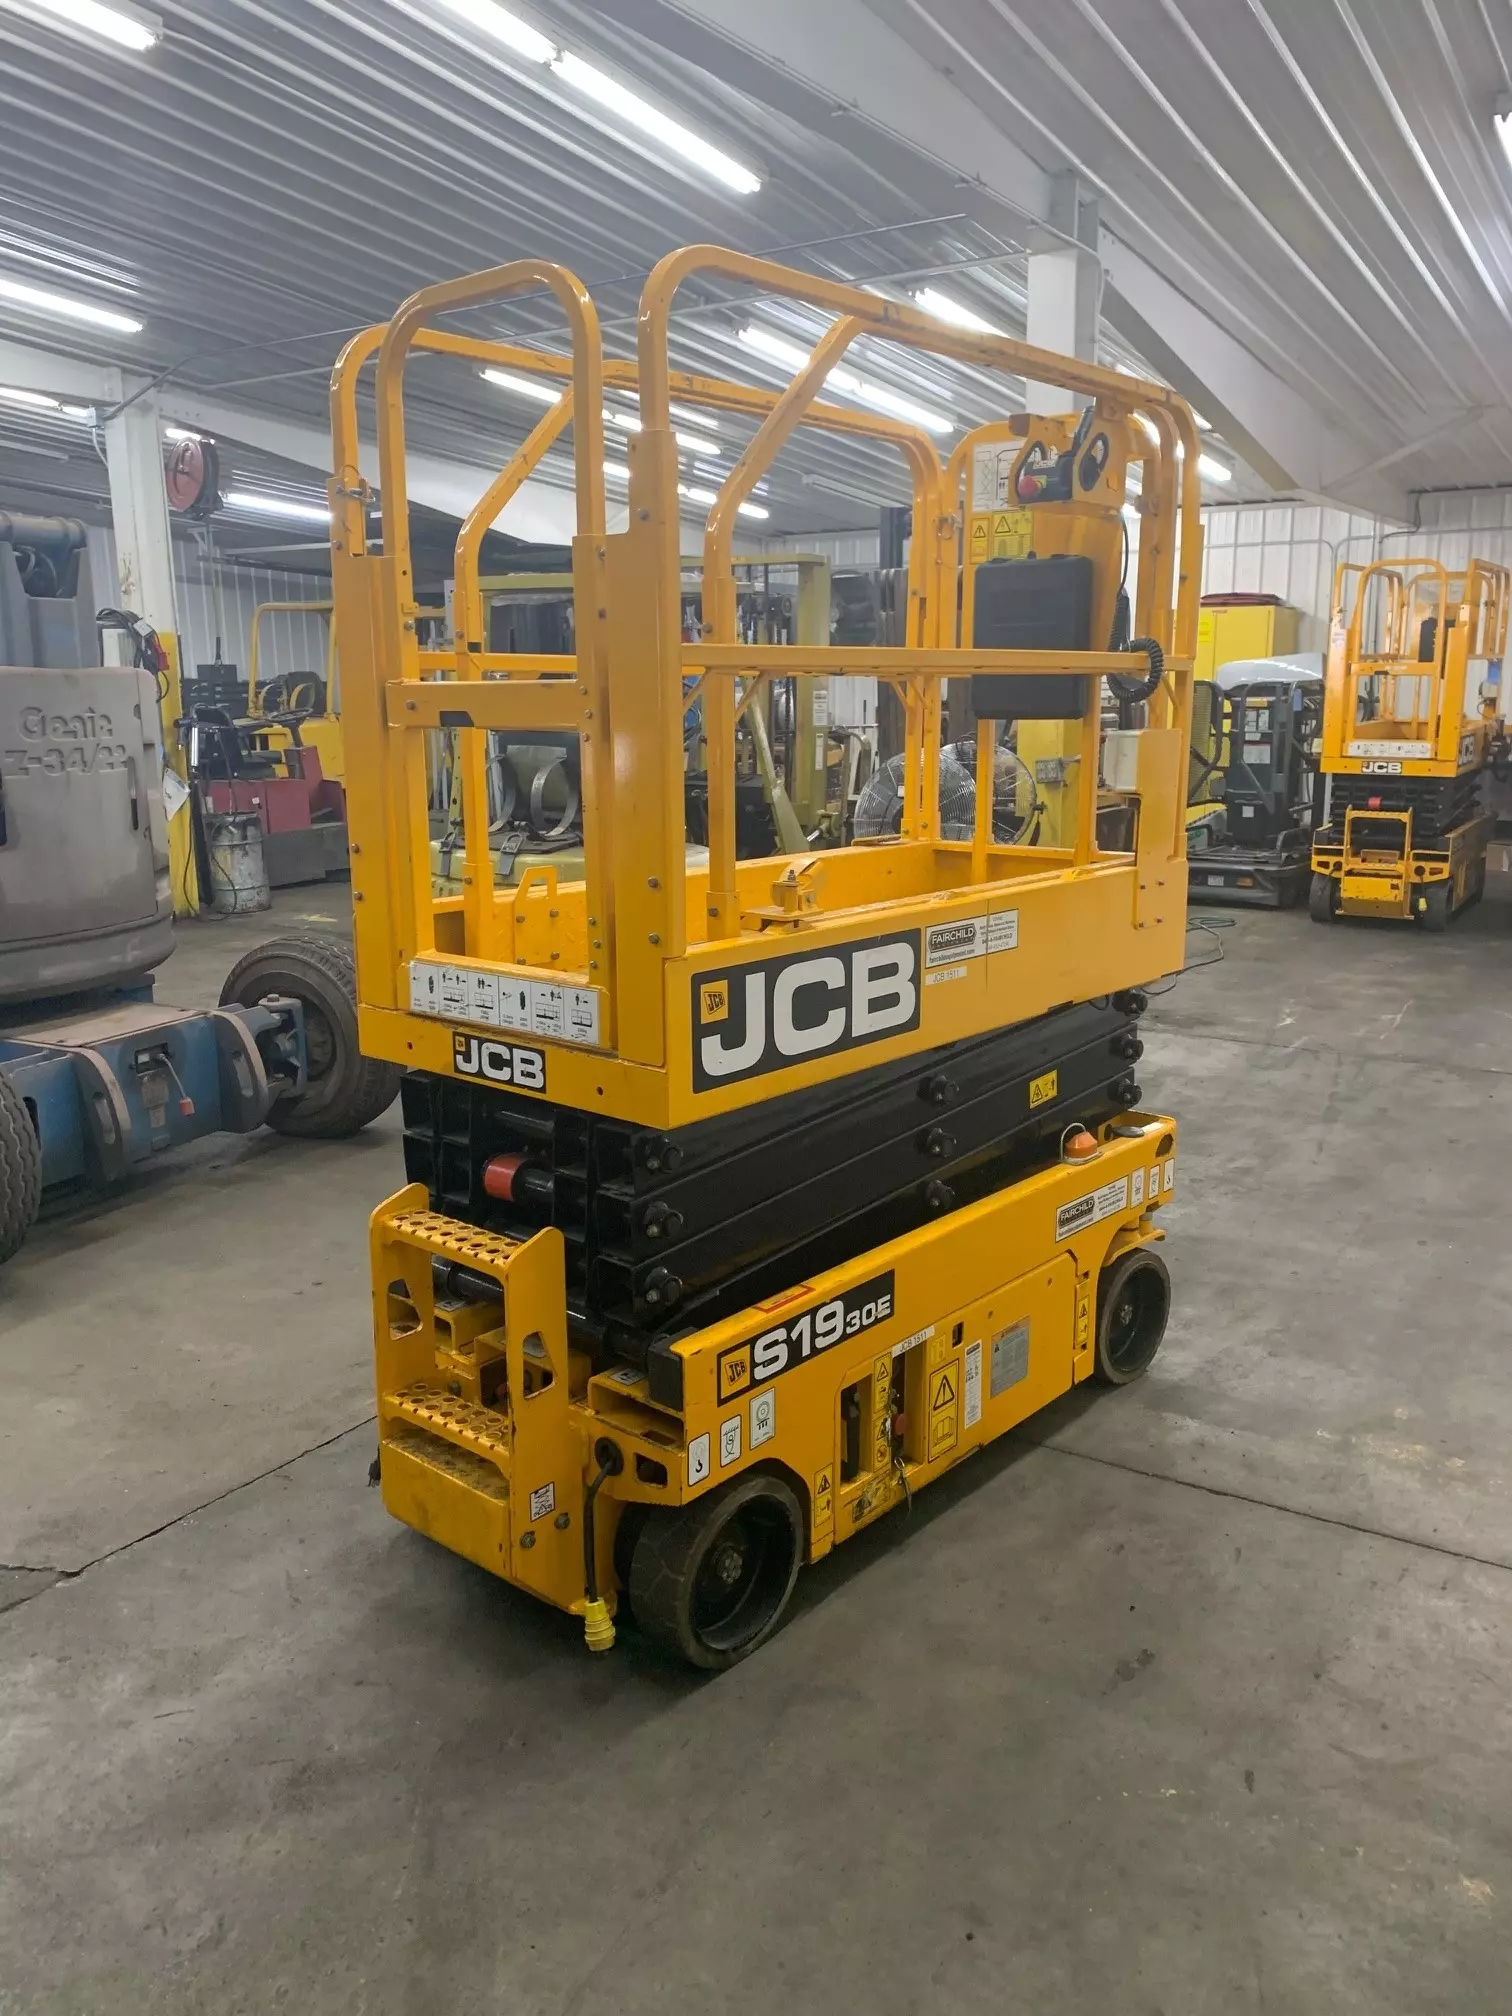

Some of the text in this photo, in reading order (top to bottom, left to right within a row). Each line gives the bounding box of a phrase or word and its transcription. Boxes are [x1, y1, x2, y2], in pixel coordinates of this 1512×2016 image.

[17, 706, 114, 743] Genie
[1361, 761, 1402, 773] JCB
[931, 927, 974, 945] FAIRCHILD
[932, 969, 960, 983] JCB 1511
[701, 942, 916, 1077] JCB
[707, 993, 725, 1014] JCB
[455, 1039, 545, 1089] JCB
[1060, 1200, 1094, 1221] FAIRCHILD
[900, 1331, 927, 1352] JCB 1511
[729, 1361, 746, 1383] JCB
